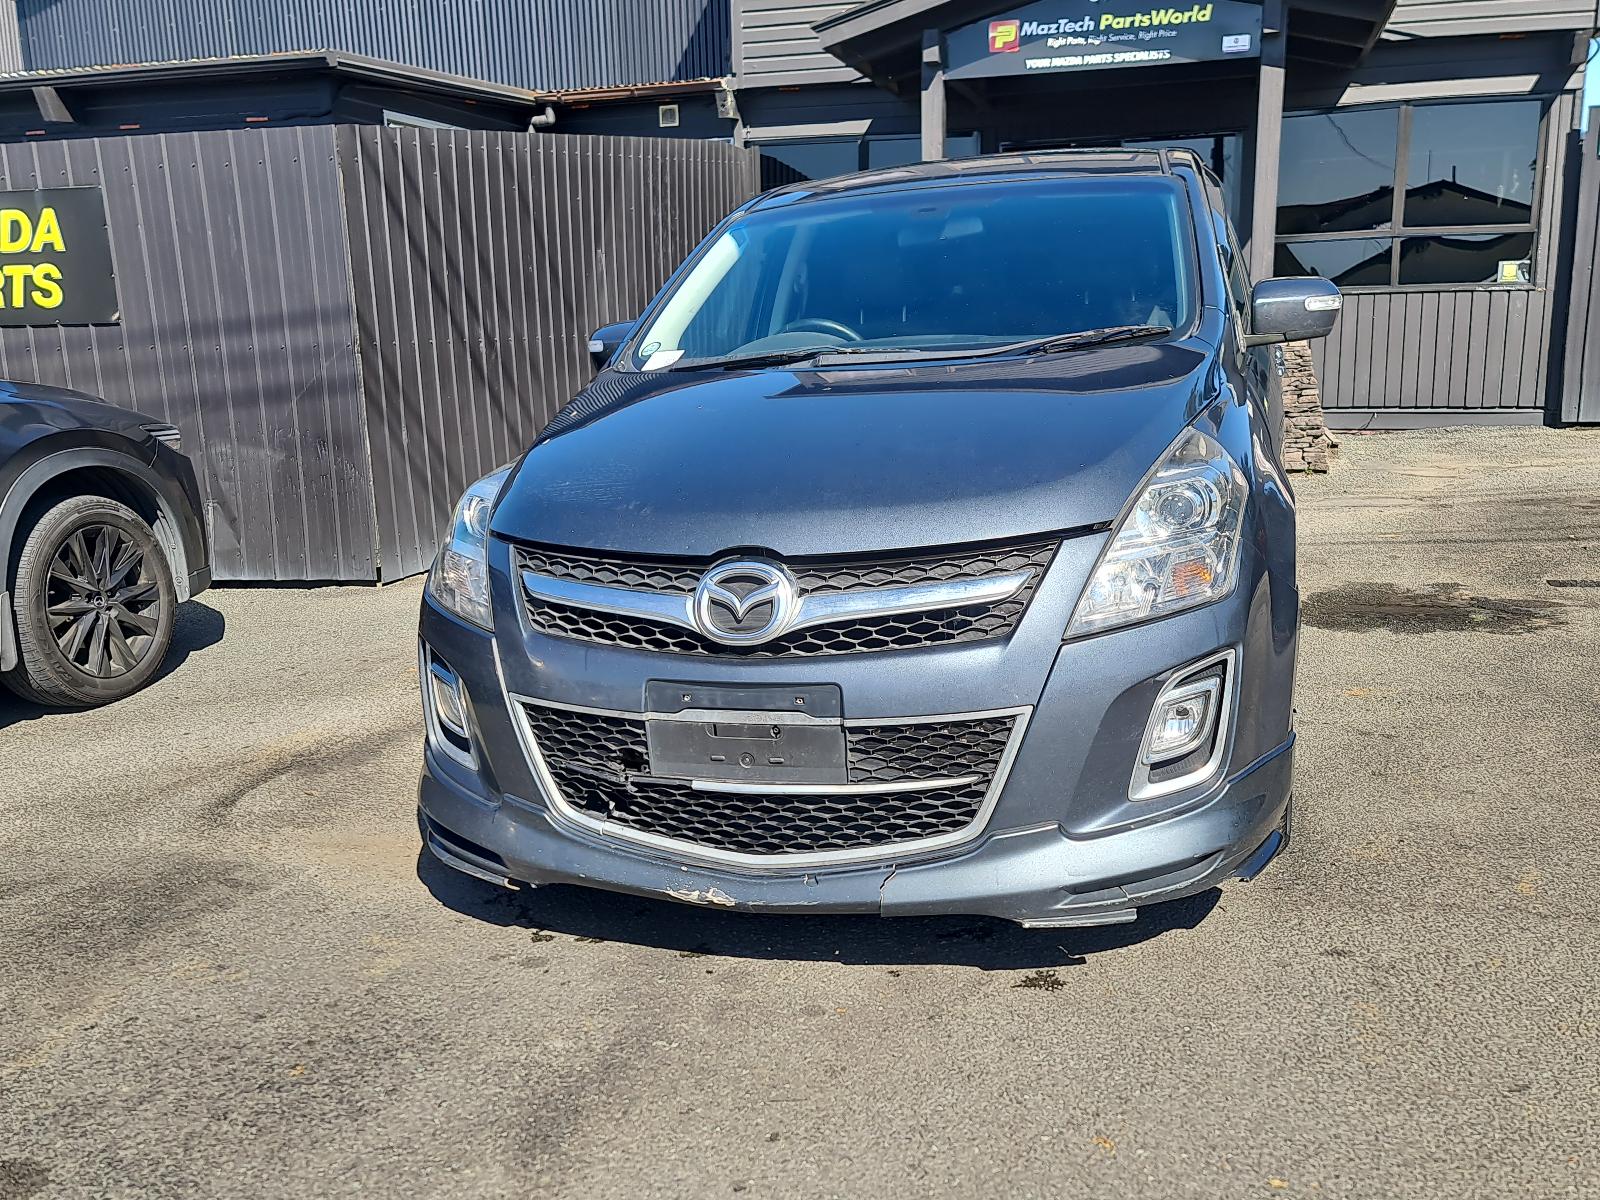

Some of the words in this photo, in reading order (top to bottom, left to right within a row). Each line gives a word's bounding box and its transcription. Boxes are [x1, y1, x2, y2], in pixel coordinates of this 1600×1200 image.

[1021, 16, 1095, 36] MazTech
[1099, 4, 1213, 30] PartsWorld
[1084, 53, 1113, 65] PARTS
[1113, 50, 1171, 63] SPECIALISTS
[0, 263, 64, 309] TS
